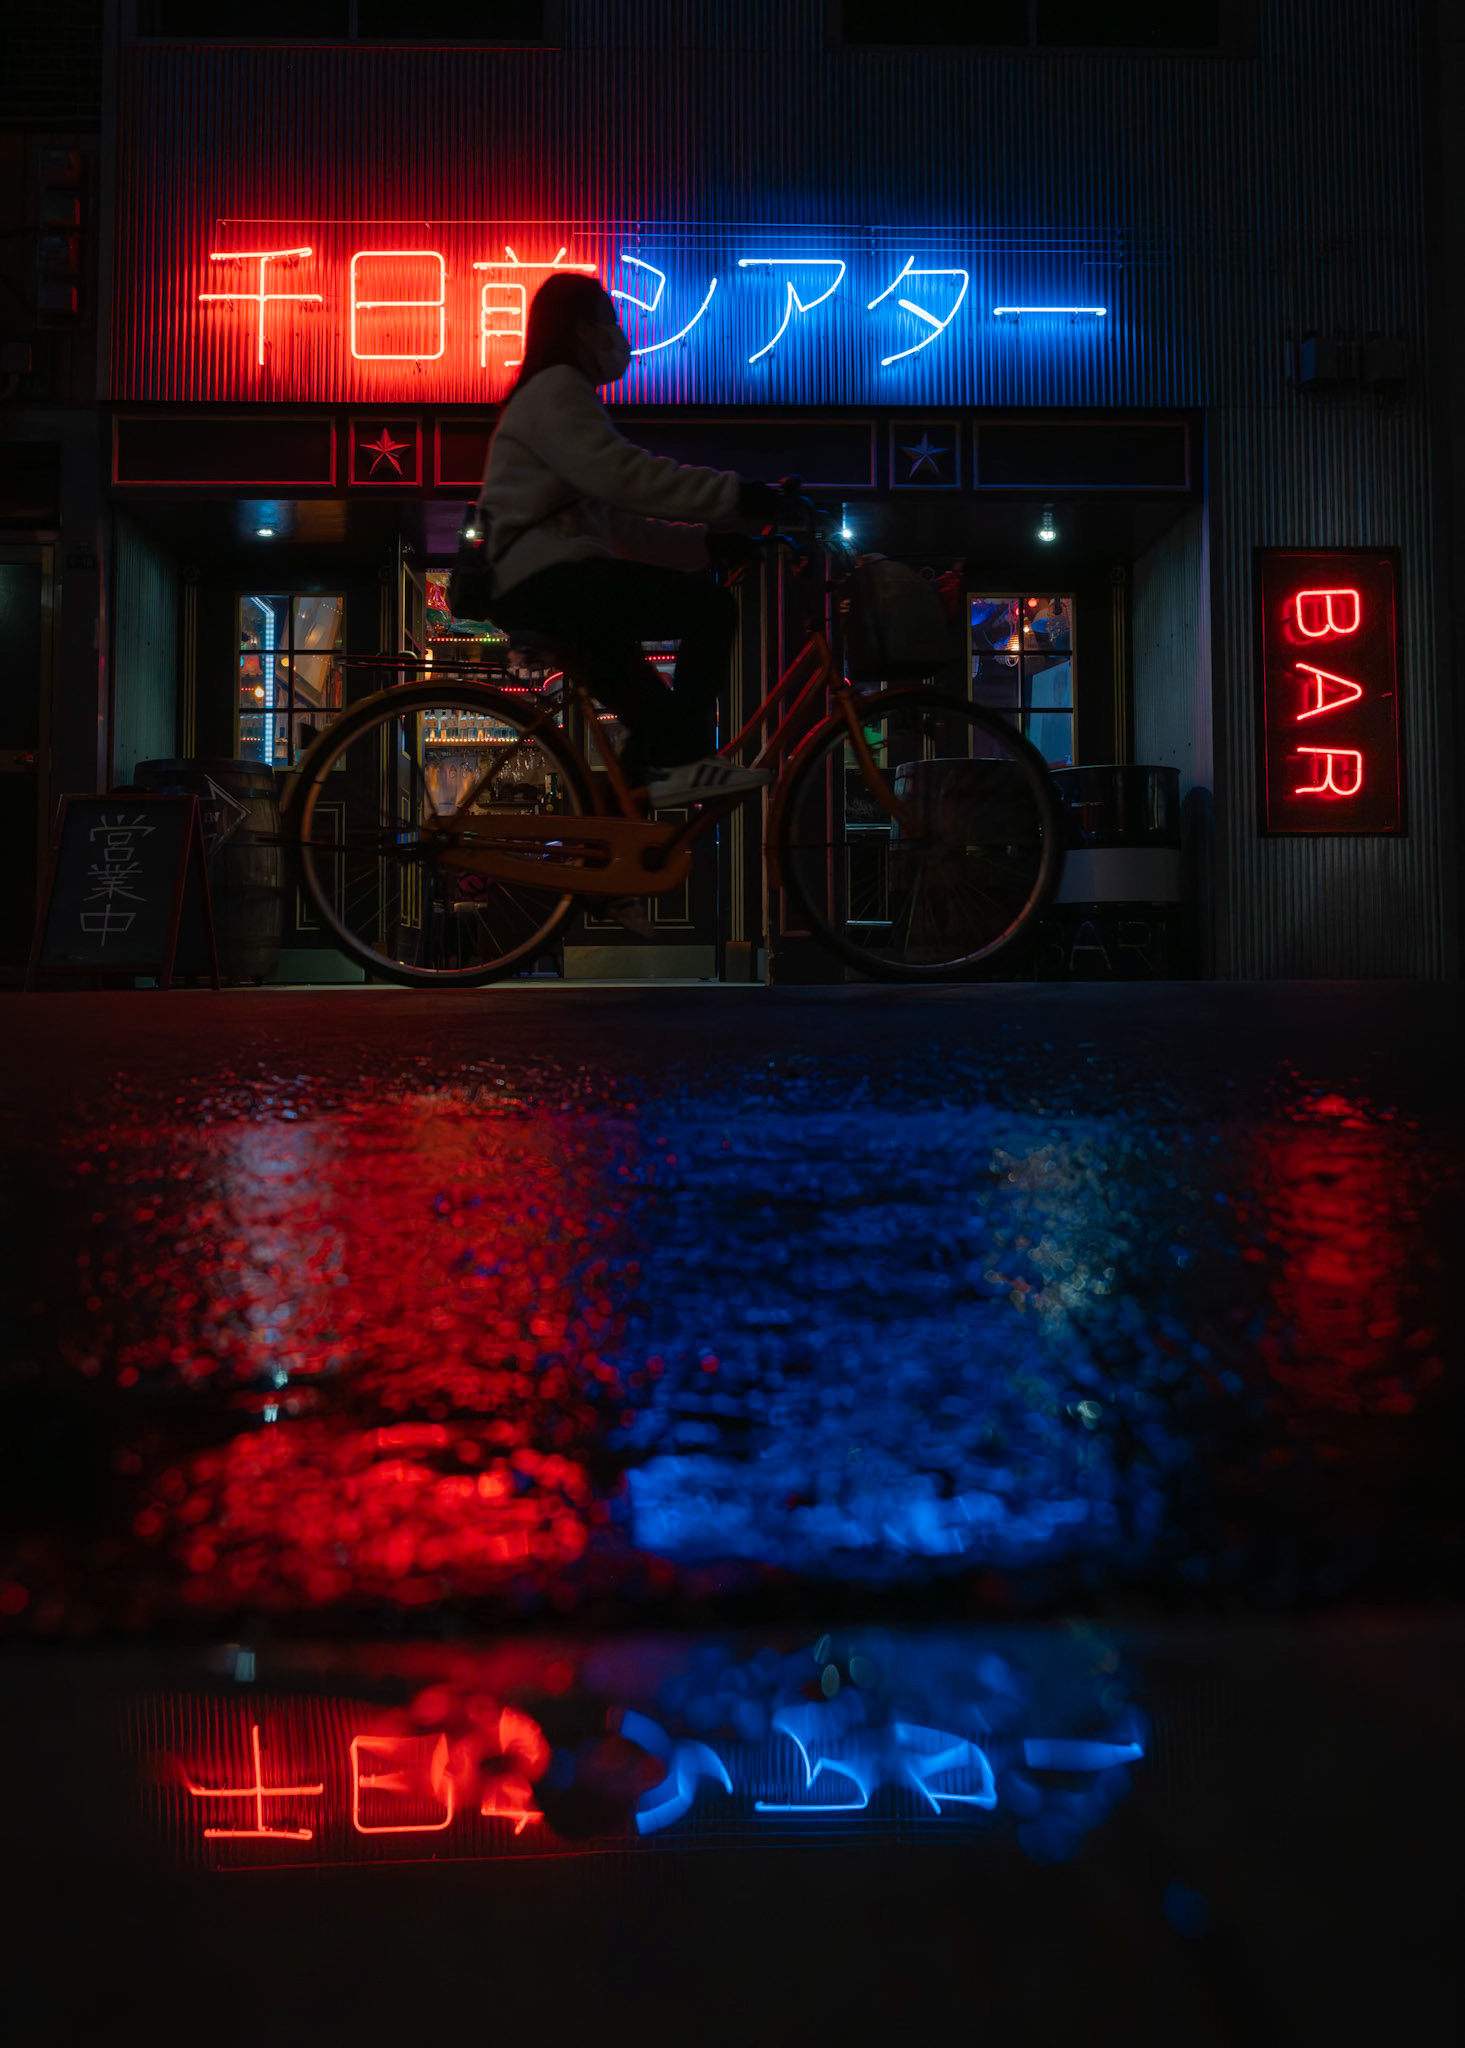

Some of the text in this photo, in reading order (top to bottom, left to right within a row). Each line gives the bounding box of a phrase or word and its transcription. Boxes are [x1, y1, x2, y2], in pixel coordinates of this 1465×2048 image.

[1295, 589, 1362, 795] BAR
[79, 814, 157, 947] 営業中
